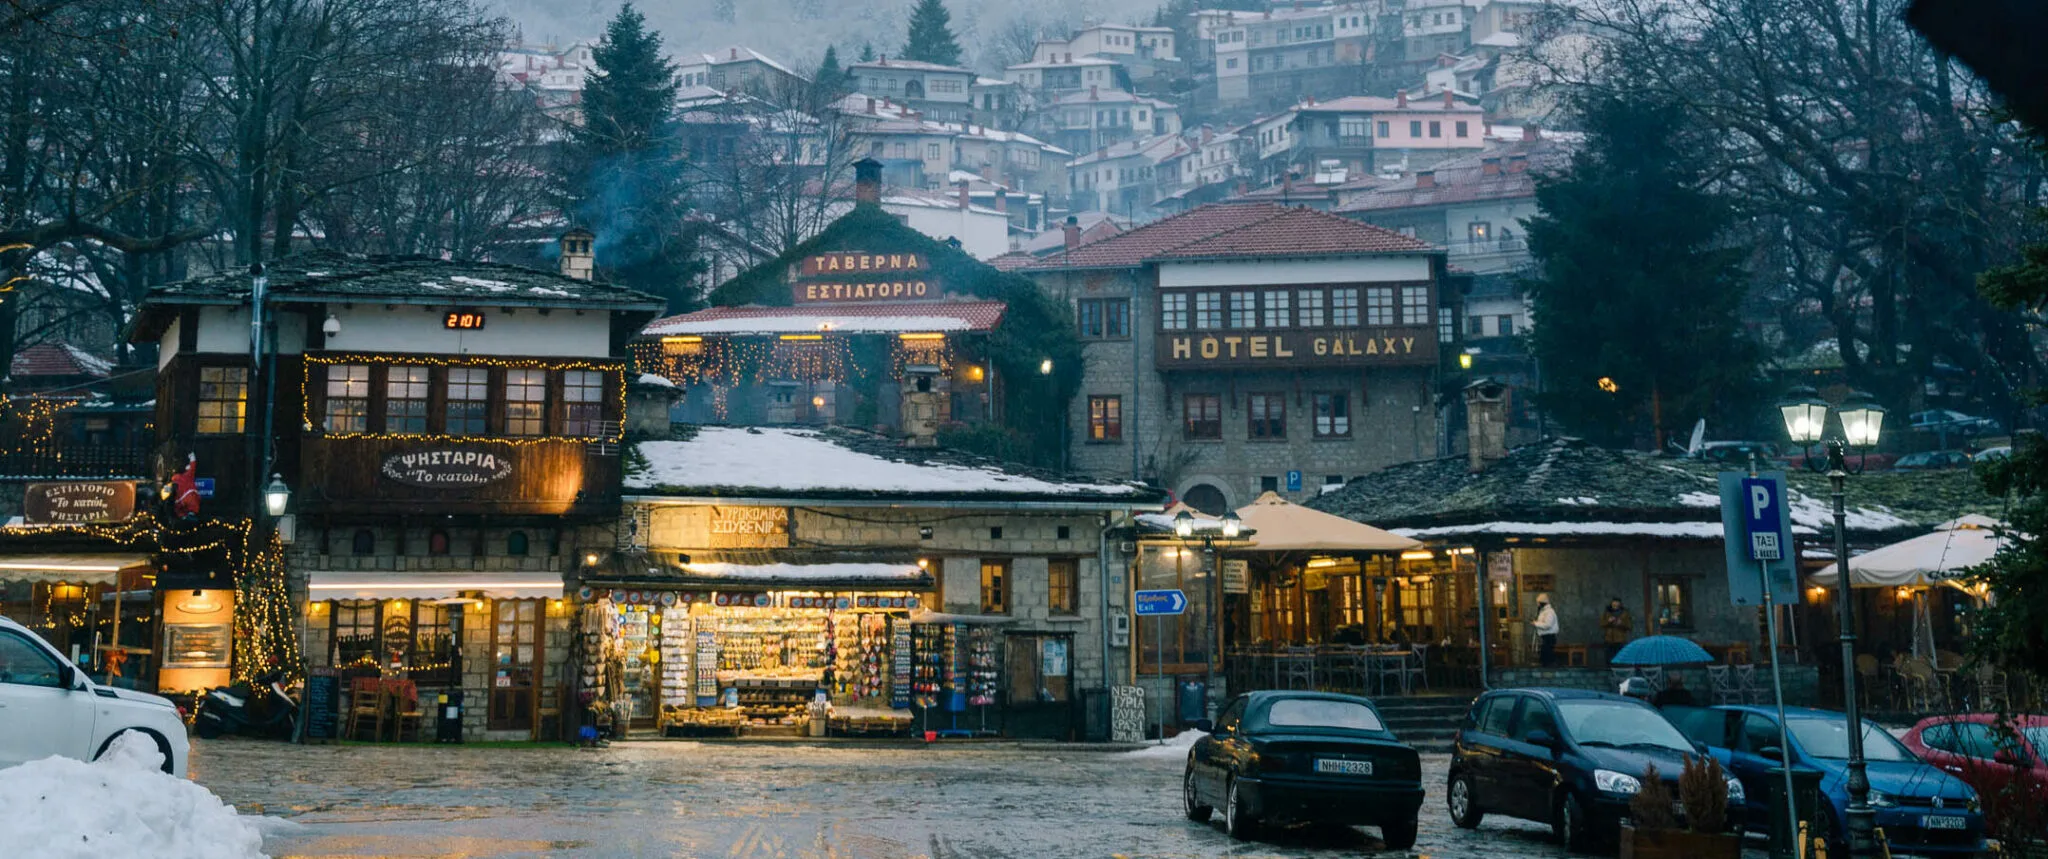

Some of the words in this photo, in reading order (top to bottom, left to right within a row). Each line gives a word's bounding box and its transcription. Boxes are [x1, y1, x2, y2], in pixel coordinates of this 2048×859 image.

[815, 253, 918, 271] ΤΑΒΕΡΝΑ
[806, 281, 927, 299] ΕΣΤΙΑΤΟΡΙΟ
[1172, 336, 1294, 359] HOTEL
[1313, 337, 1415, 356] GALAXY
[401, 451, 496, 470] ΨΗΣΤΑΡΙΑ
[45, 484, 115, 498] ΕΣΤΙΑΤΟΡΙΟ
[1750, 485, 1770, 520] P
[50, 510, 109, 521] ΨΗΣΤΑΡΙΑ
